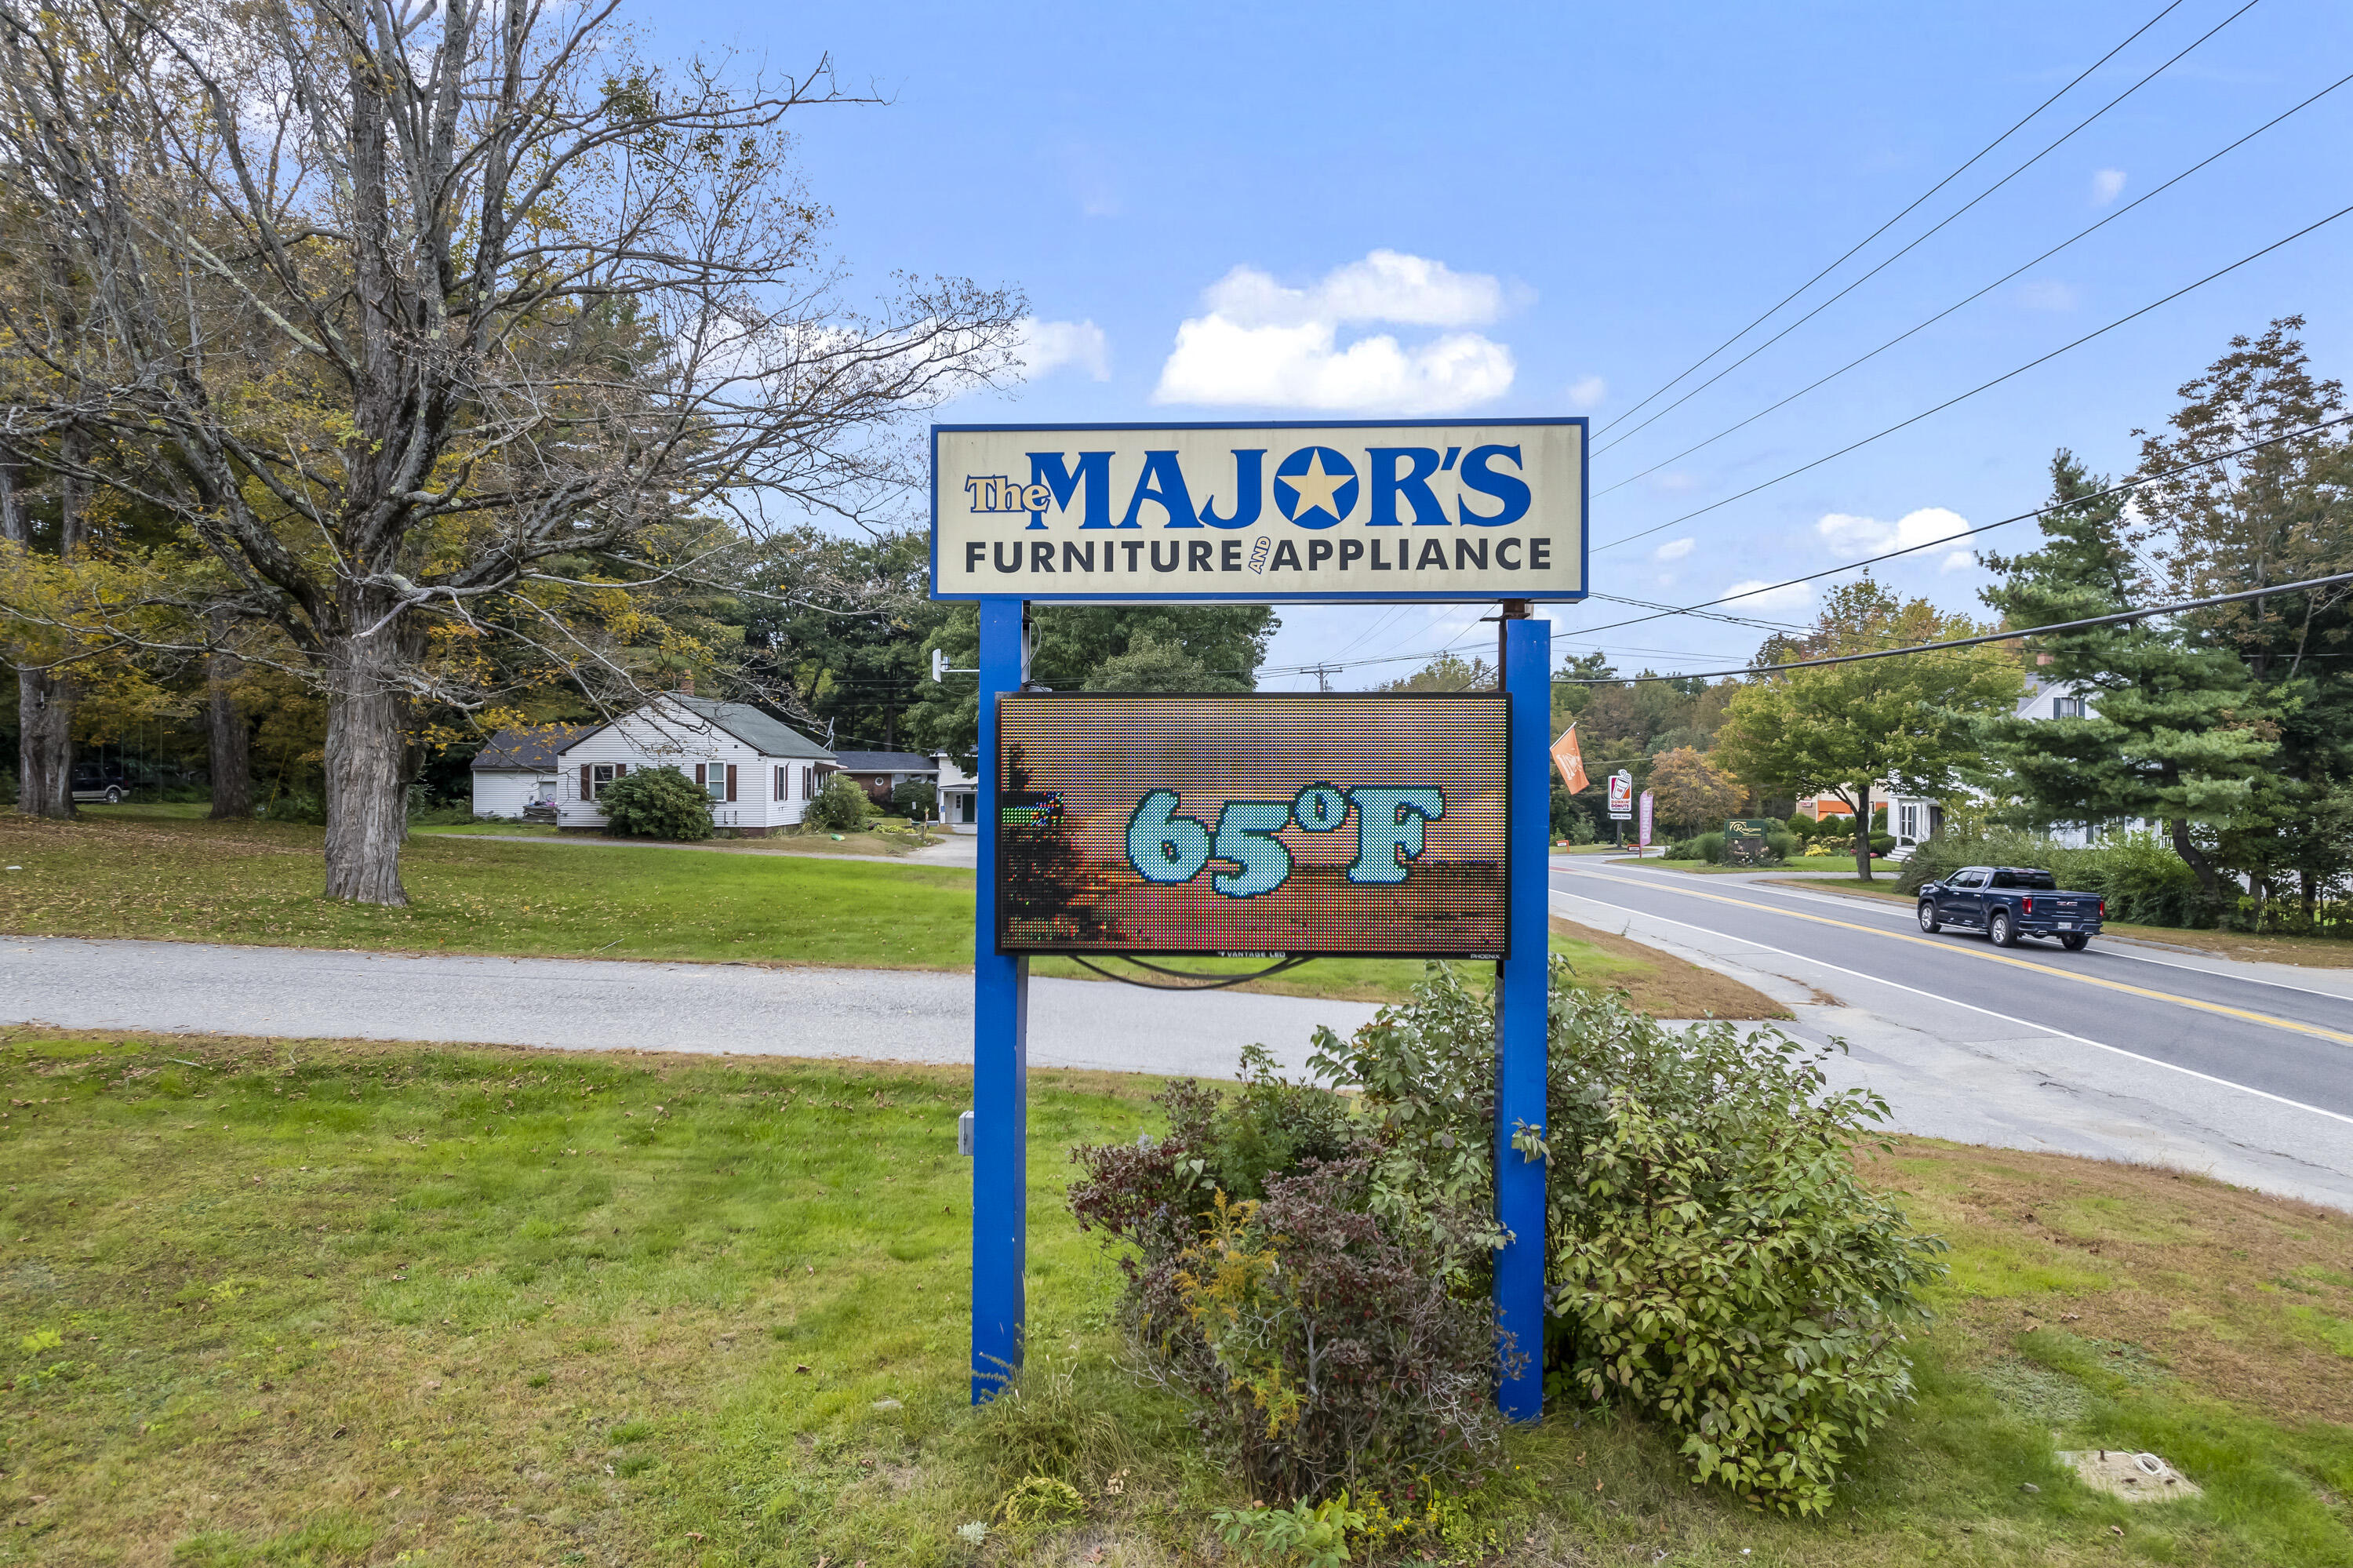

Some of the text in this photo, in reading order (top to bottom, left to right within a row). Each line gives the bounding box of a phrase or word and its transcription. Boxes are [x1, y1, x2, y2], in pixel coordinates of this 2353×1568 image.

[965, 444, 1532, 529] The MAJOR'S
[966, 535, 1552, 575] FURNITURE AND APPLIANCE
